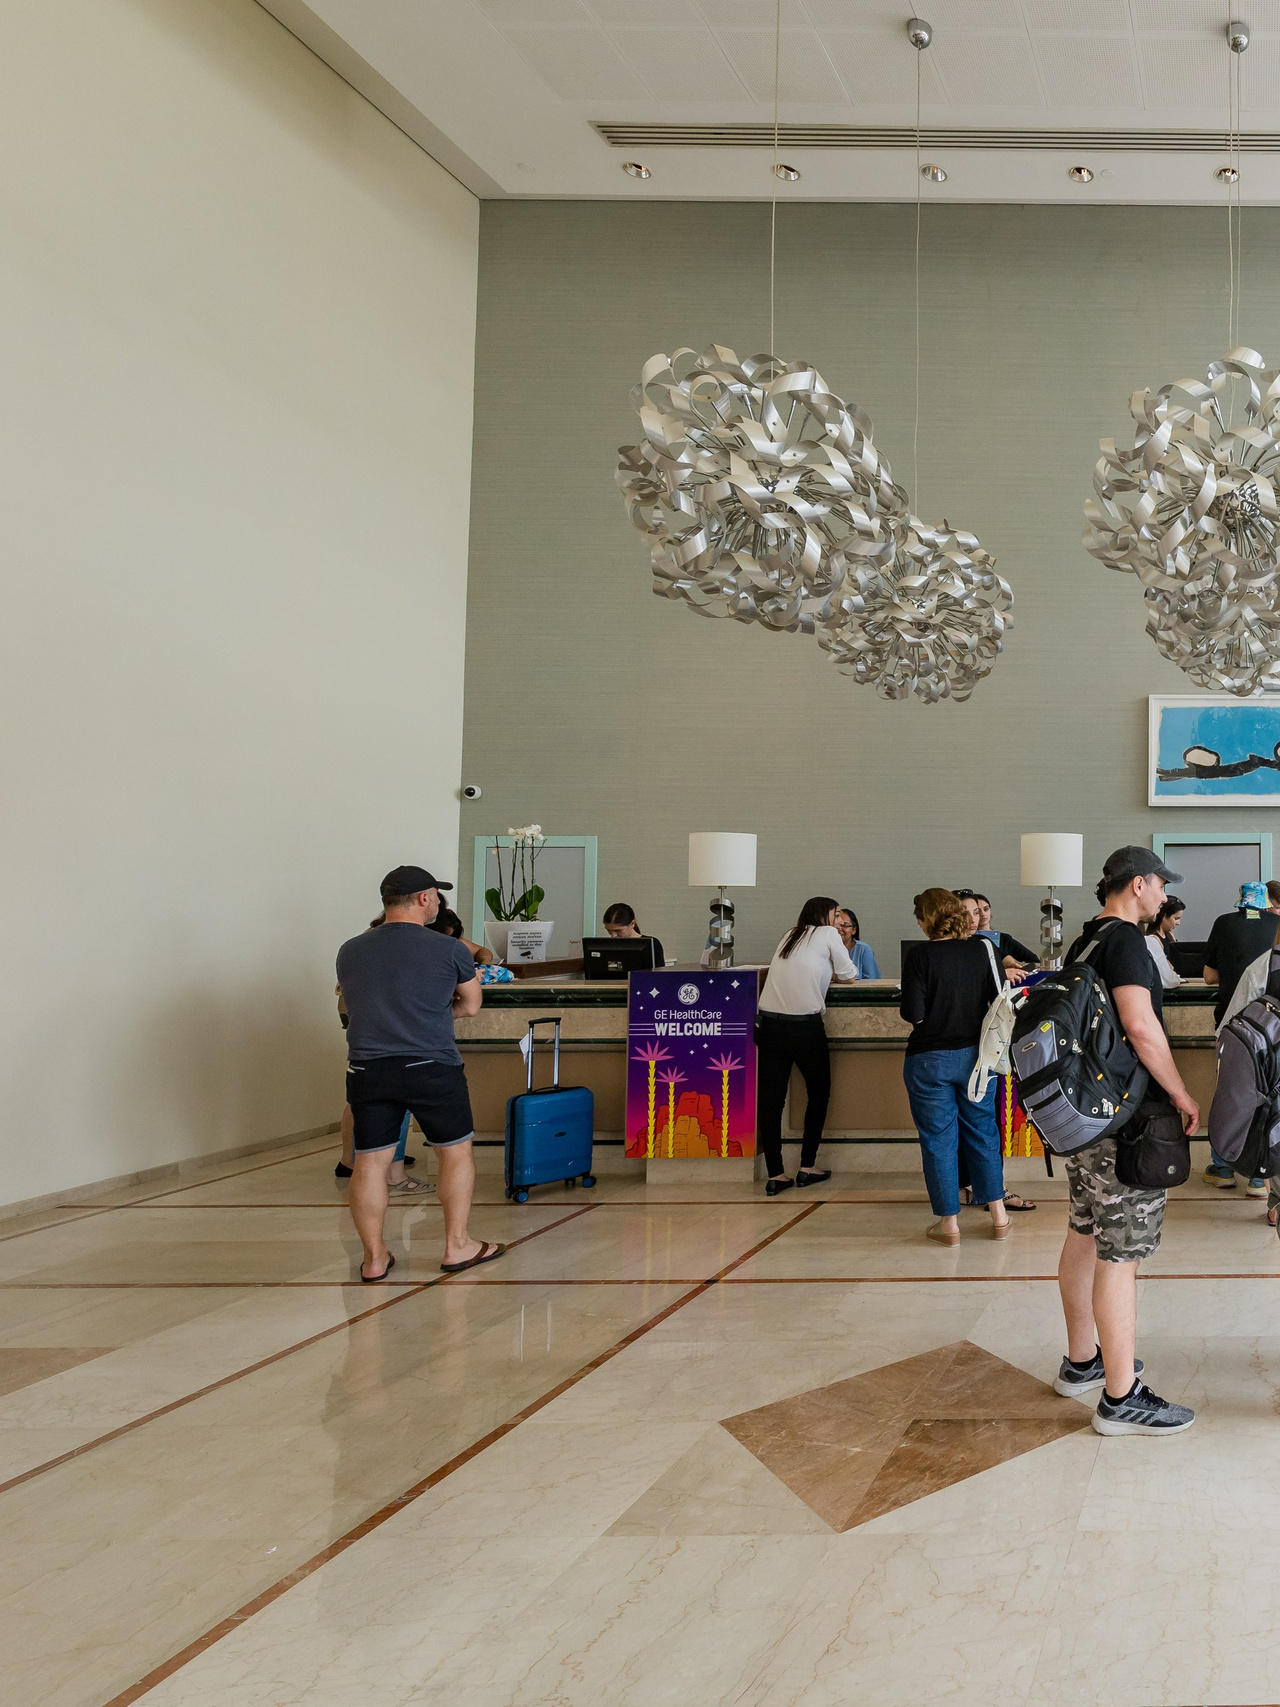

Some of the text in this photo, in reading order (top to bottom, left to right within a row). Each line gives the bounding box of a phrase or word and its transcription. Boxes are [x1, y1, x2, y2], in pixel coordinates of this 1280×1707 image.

[654, 1009, 722, 1020] GE HealthCare
[654, 1022, 722, 1036] WELCOME
